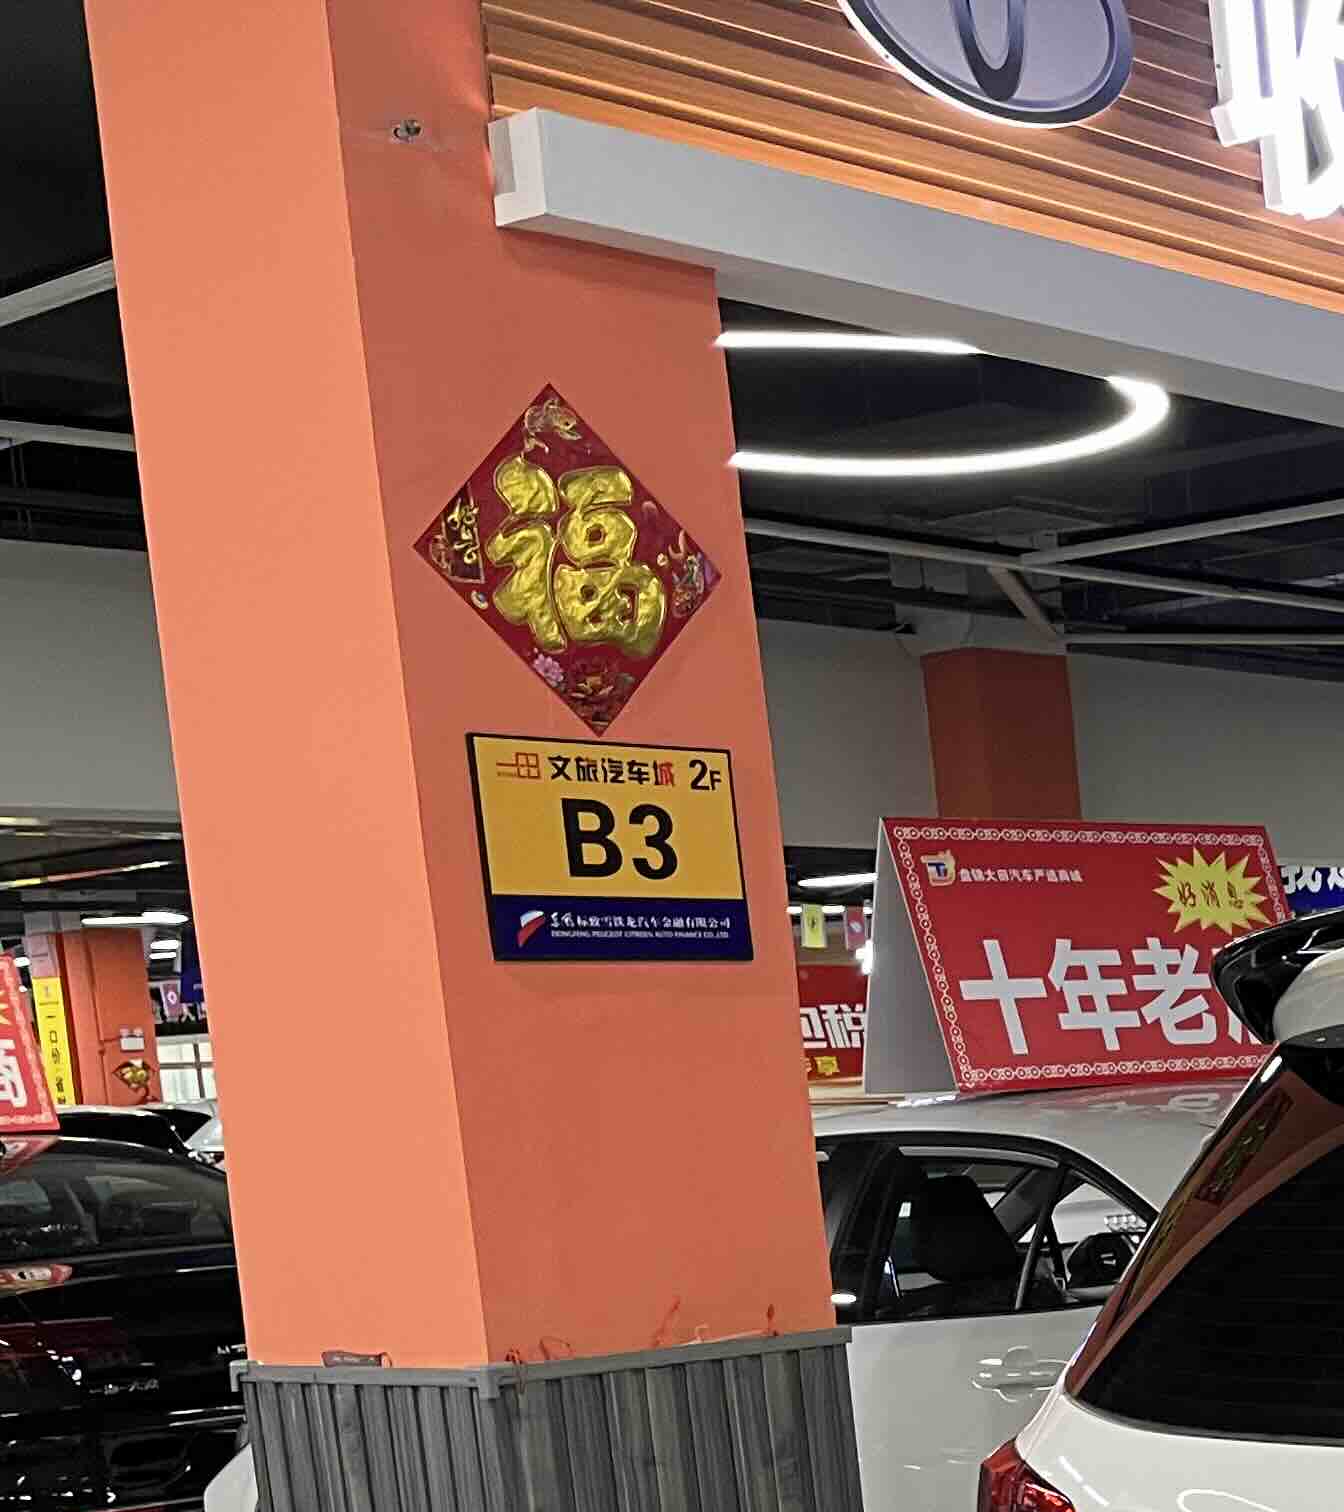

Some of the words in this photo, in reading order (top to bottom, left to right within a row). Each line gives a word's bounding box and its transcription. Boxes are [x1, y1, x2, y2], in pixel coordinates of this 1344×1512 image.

[485, 455, 667, 655] 福
[547, 755, 675, 787] 文旅汽车城
[688, 759, 722, 790] 2F
[561, 797, 678, 880] B3
